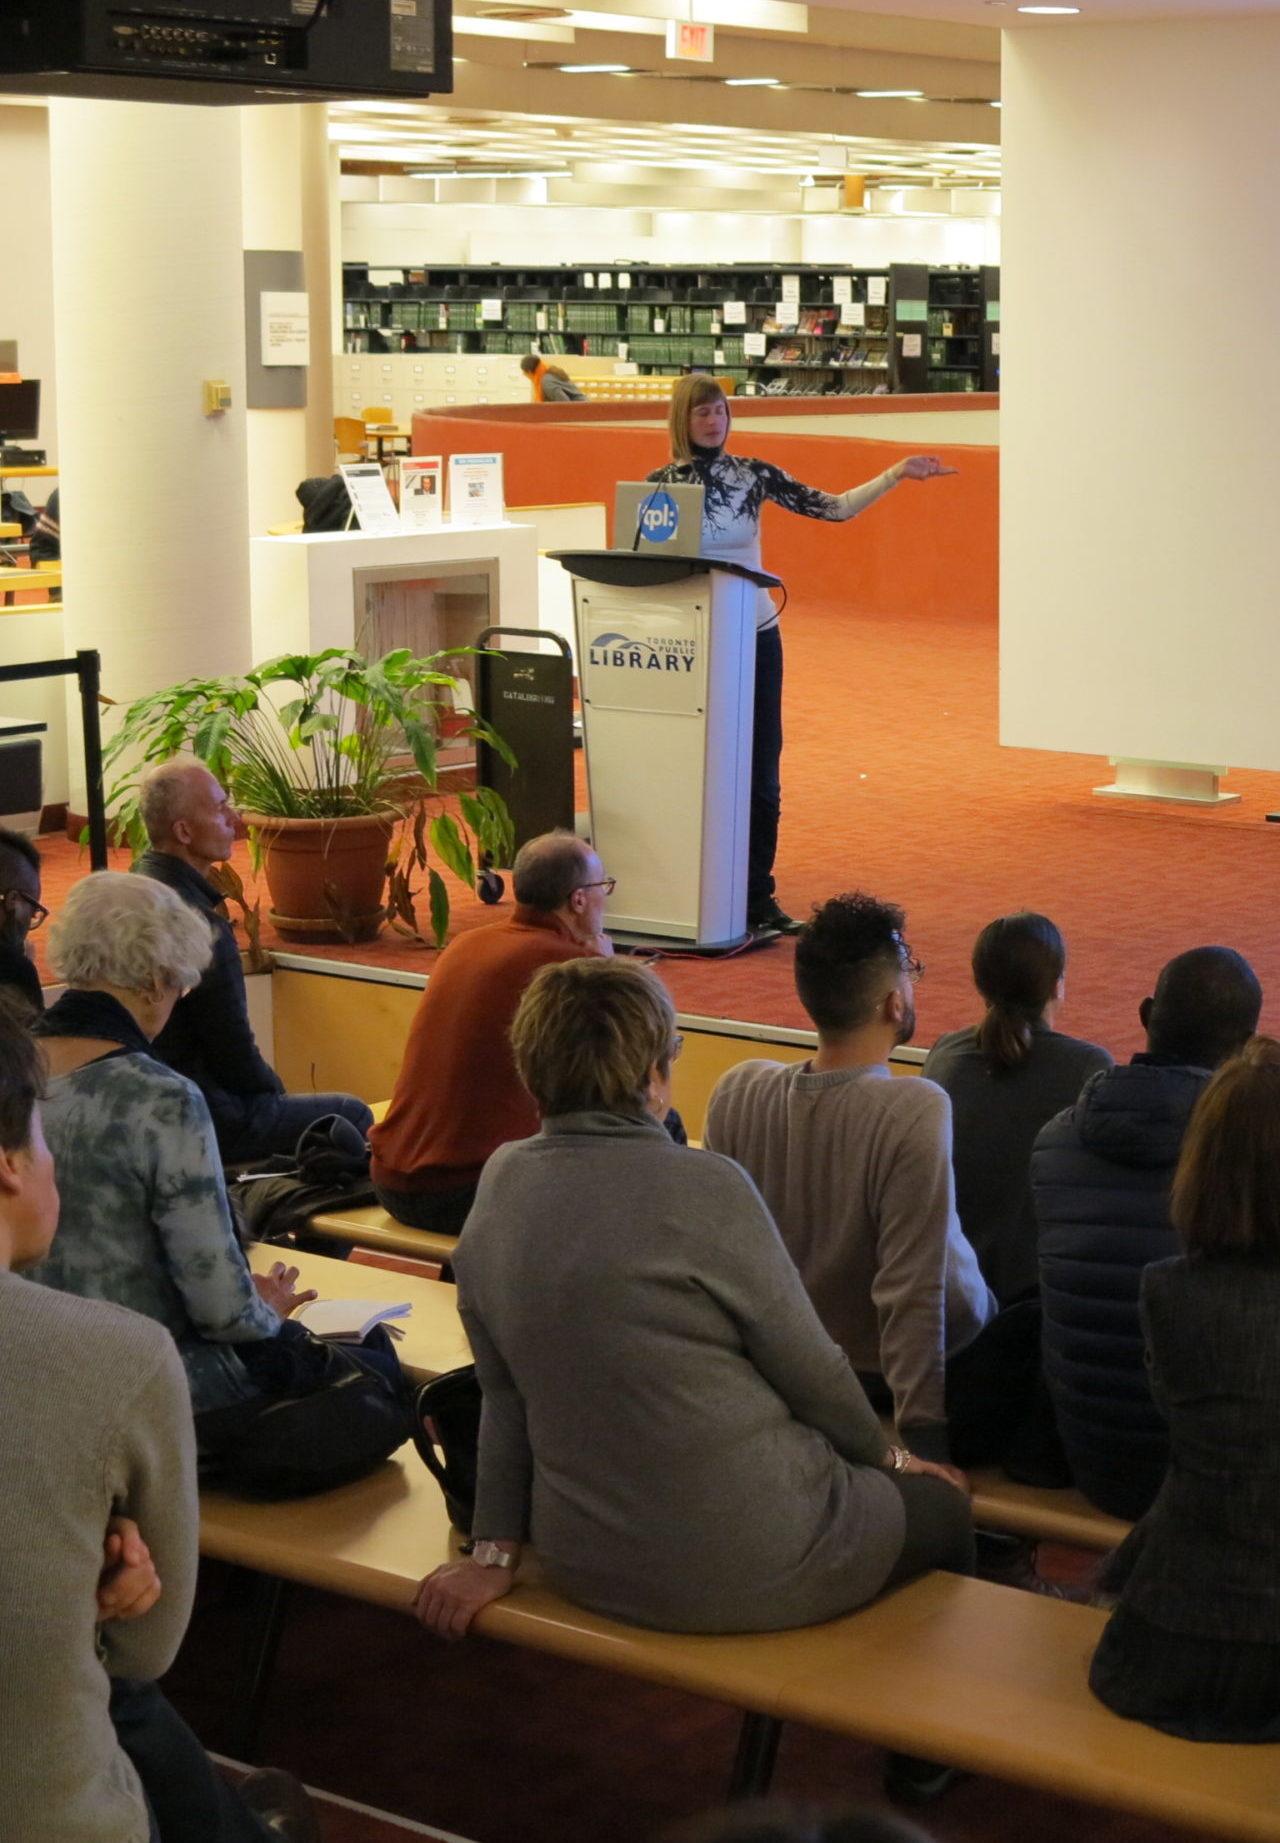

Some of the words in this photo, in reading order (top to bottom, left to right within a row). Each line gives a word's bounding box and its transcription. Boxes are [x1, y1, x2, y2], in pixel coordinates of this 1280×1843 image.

[680, 25, 708, 48] EXIT
[646, 636, 697, 648] TORONTO
[658, 645, 696, 656] PUBLIC
[589, 648, 696, 673] LIBRARY
